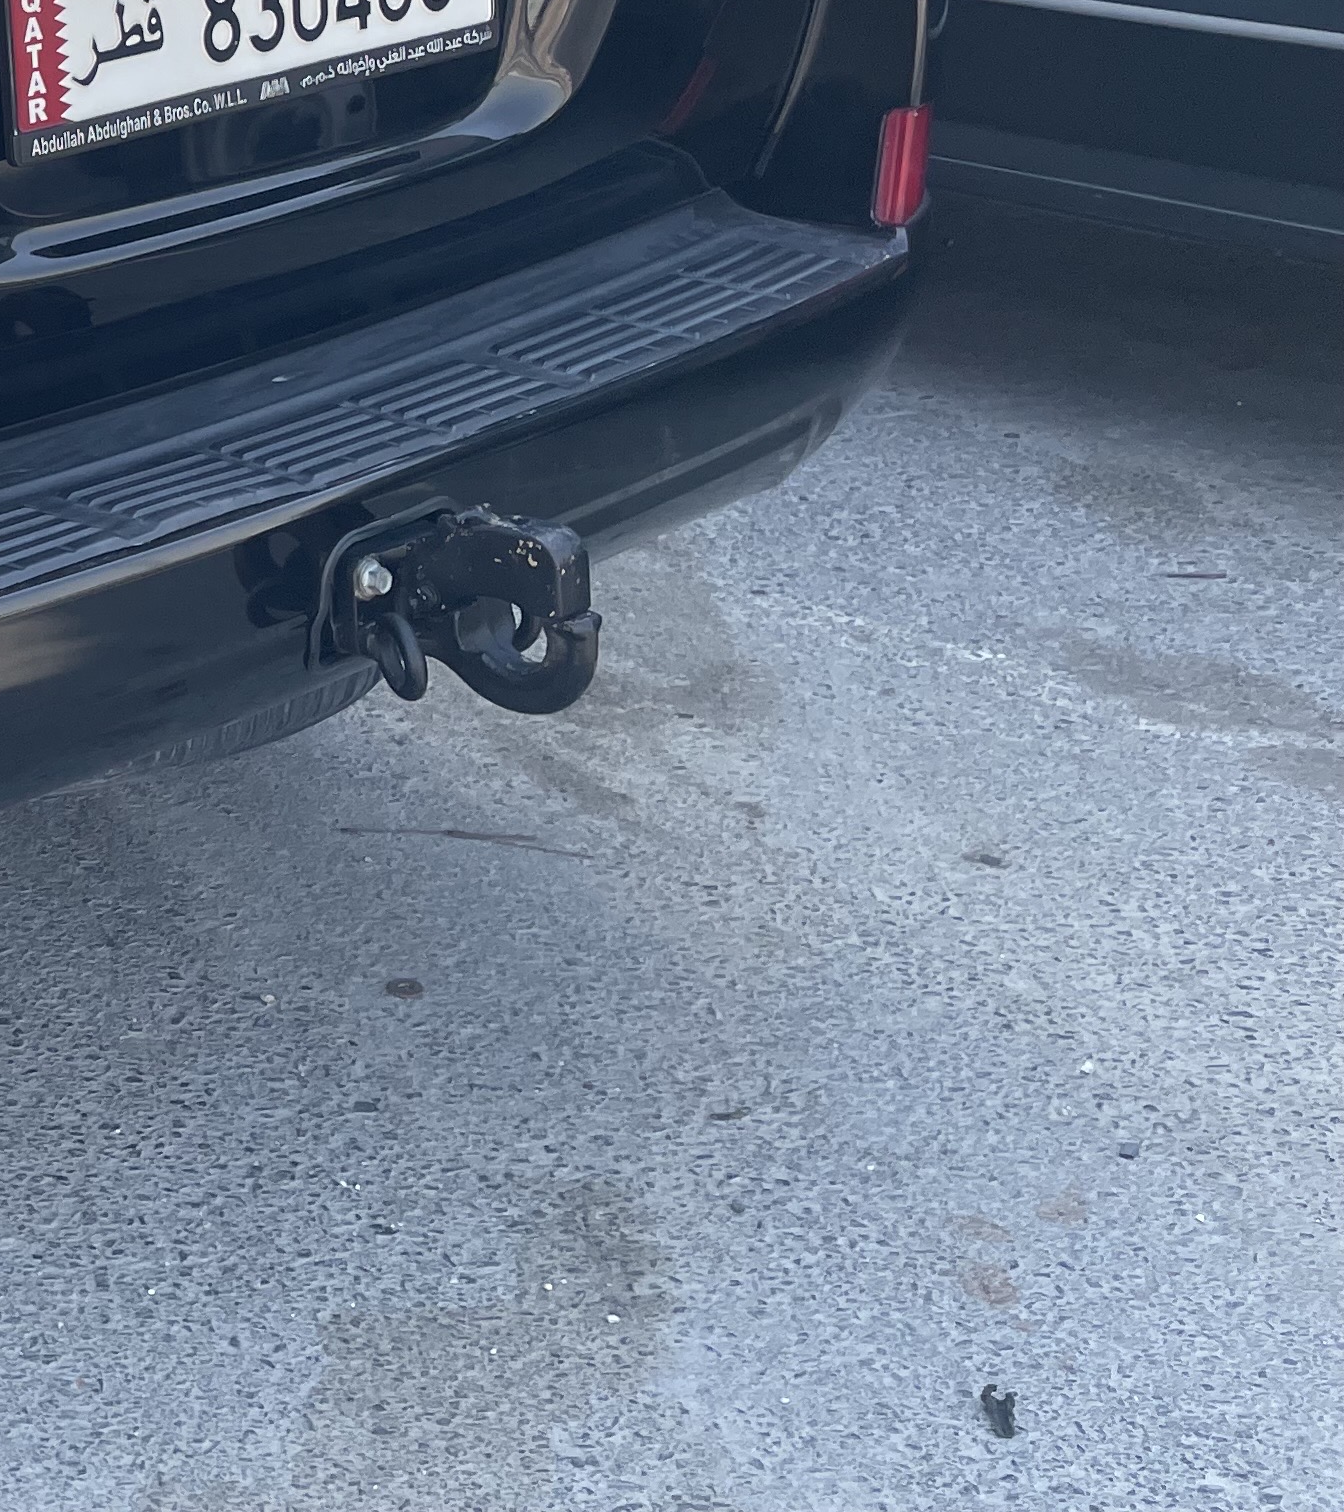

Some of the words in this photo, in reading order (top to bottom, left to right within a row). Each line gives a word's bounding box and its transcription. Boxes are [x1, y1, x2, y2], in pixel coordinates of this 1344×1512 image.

[462, 24, 492, 46] شركة
[31, 128, 85, 157] Abdullah
[87, 112, 151, 145] Abdulghani
[153, 109, 162, 127] &
[164, 104, 193, 124] Bros.
[193, 98, 212, 116] Co.
